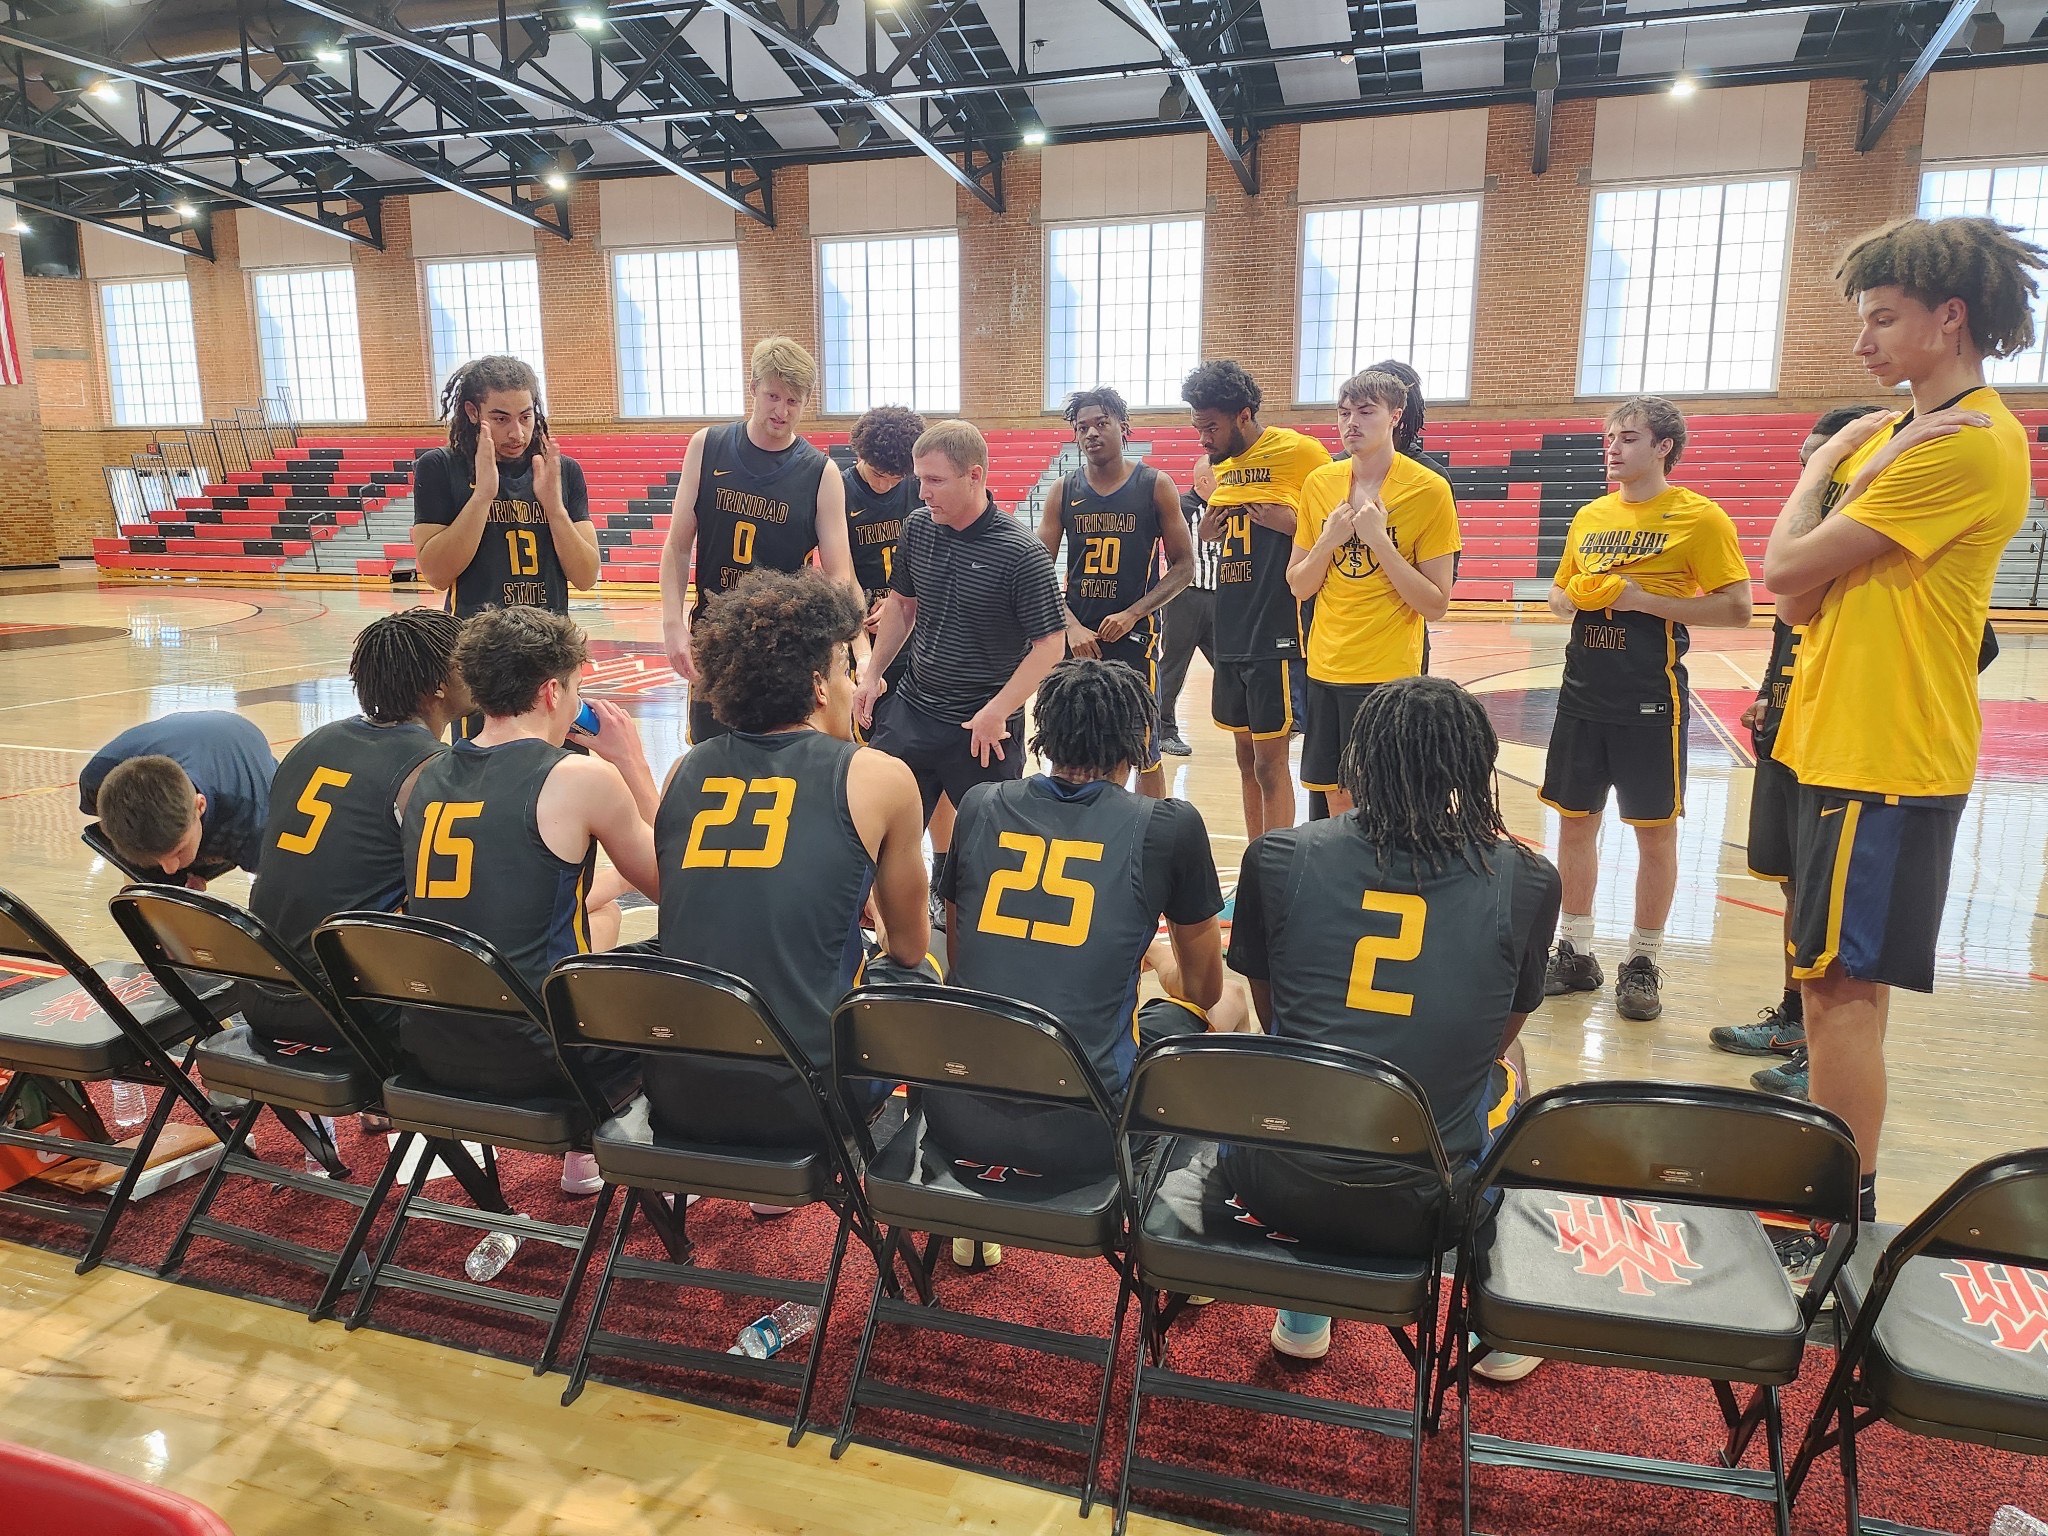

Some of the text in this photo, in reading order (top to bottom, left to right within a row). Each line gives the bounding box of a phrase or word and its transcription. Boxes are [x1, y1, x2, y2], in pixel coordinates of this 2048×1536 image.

[1245, 467, 1271, 483] STATE
[716, 488, 789, 524] TRINIDAD
[1074, 512, 1136, 534] TRINIDAD
[732, 520, 757, 564] 0
[855, 519, 901, 545] TRINID
[1222, 513, 1251, 557] 24
[1581, 529, 1670, 548] TRINIDAD STATE
[505, 529, 539, 575] 13
[881, 545, 898, 584] 1
[1083, 537, 1121, 575] 20
[1080, 578, 1118, 599] STATE
[1219, 560, 1252, 583] STATE
[503, 581, 547, 605] STATE
[277, 765, 352, 855] 5
[681, 776, 797, 869] 23
[415, 800, 485, 899] 15
[976, 830, 1105, 947] 25
[1345, 888, 1428, 1017] 2
